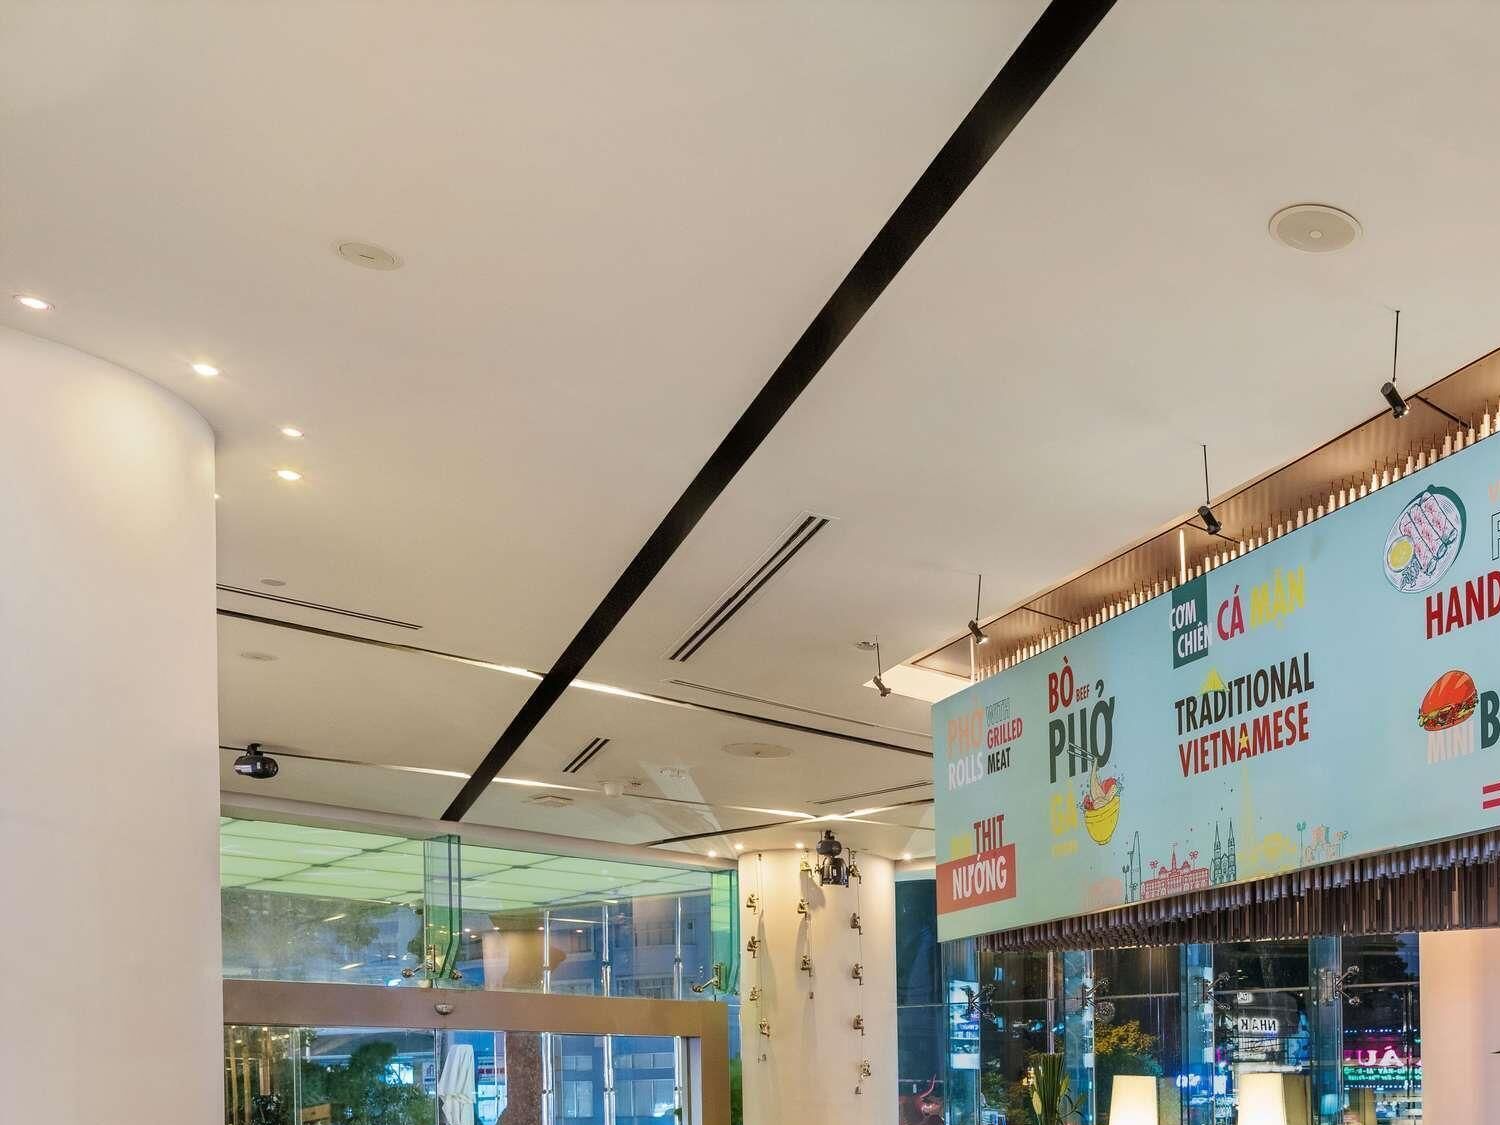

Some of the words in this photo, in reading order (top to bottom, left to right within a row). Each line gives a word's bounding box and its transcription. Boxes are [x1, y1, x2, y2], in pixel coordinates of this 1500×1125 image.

[1177, 622, 1213, 658] CHIÊN
[1216, 585, 1245, 641] CÁ
[1048, 656, 1074, 714] BÒ
[1075, 684, 1090, 702] BEEF
[1174, 652, 1315, 736] TRADITIONAL
[987, 717, 1023, 750] GRILLED
[1048, 679, 1116, 784] PHỞ
[1178, 701, 1309, 778] VIETNAMESE
[1427, 721, 1475, 764] MINI
[948, 752, 984, 791] ROLLS
[987, 747, 1011, 775] MEAT
